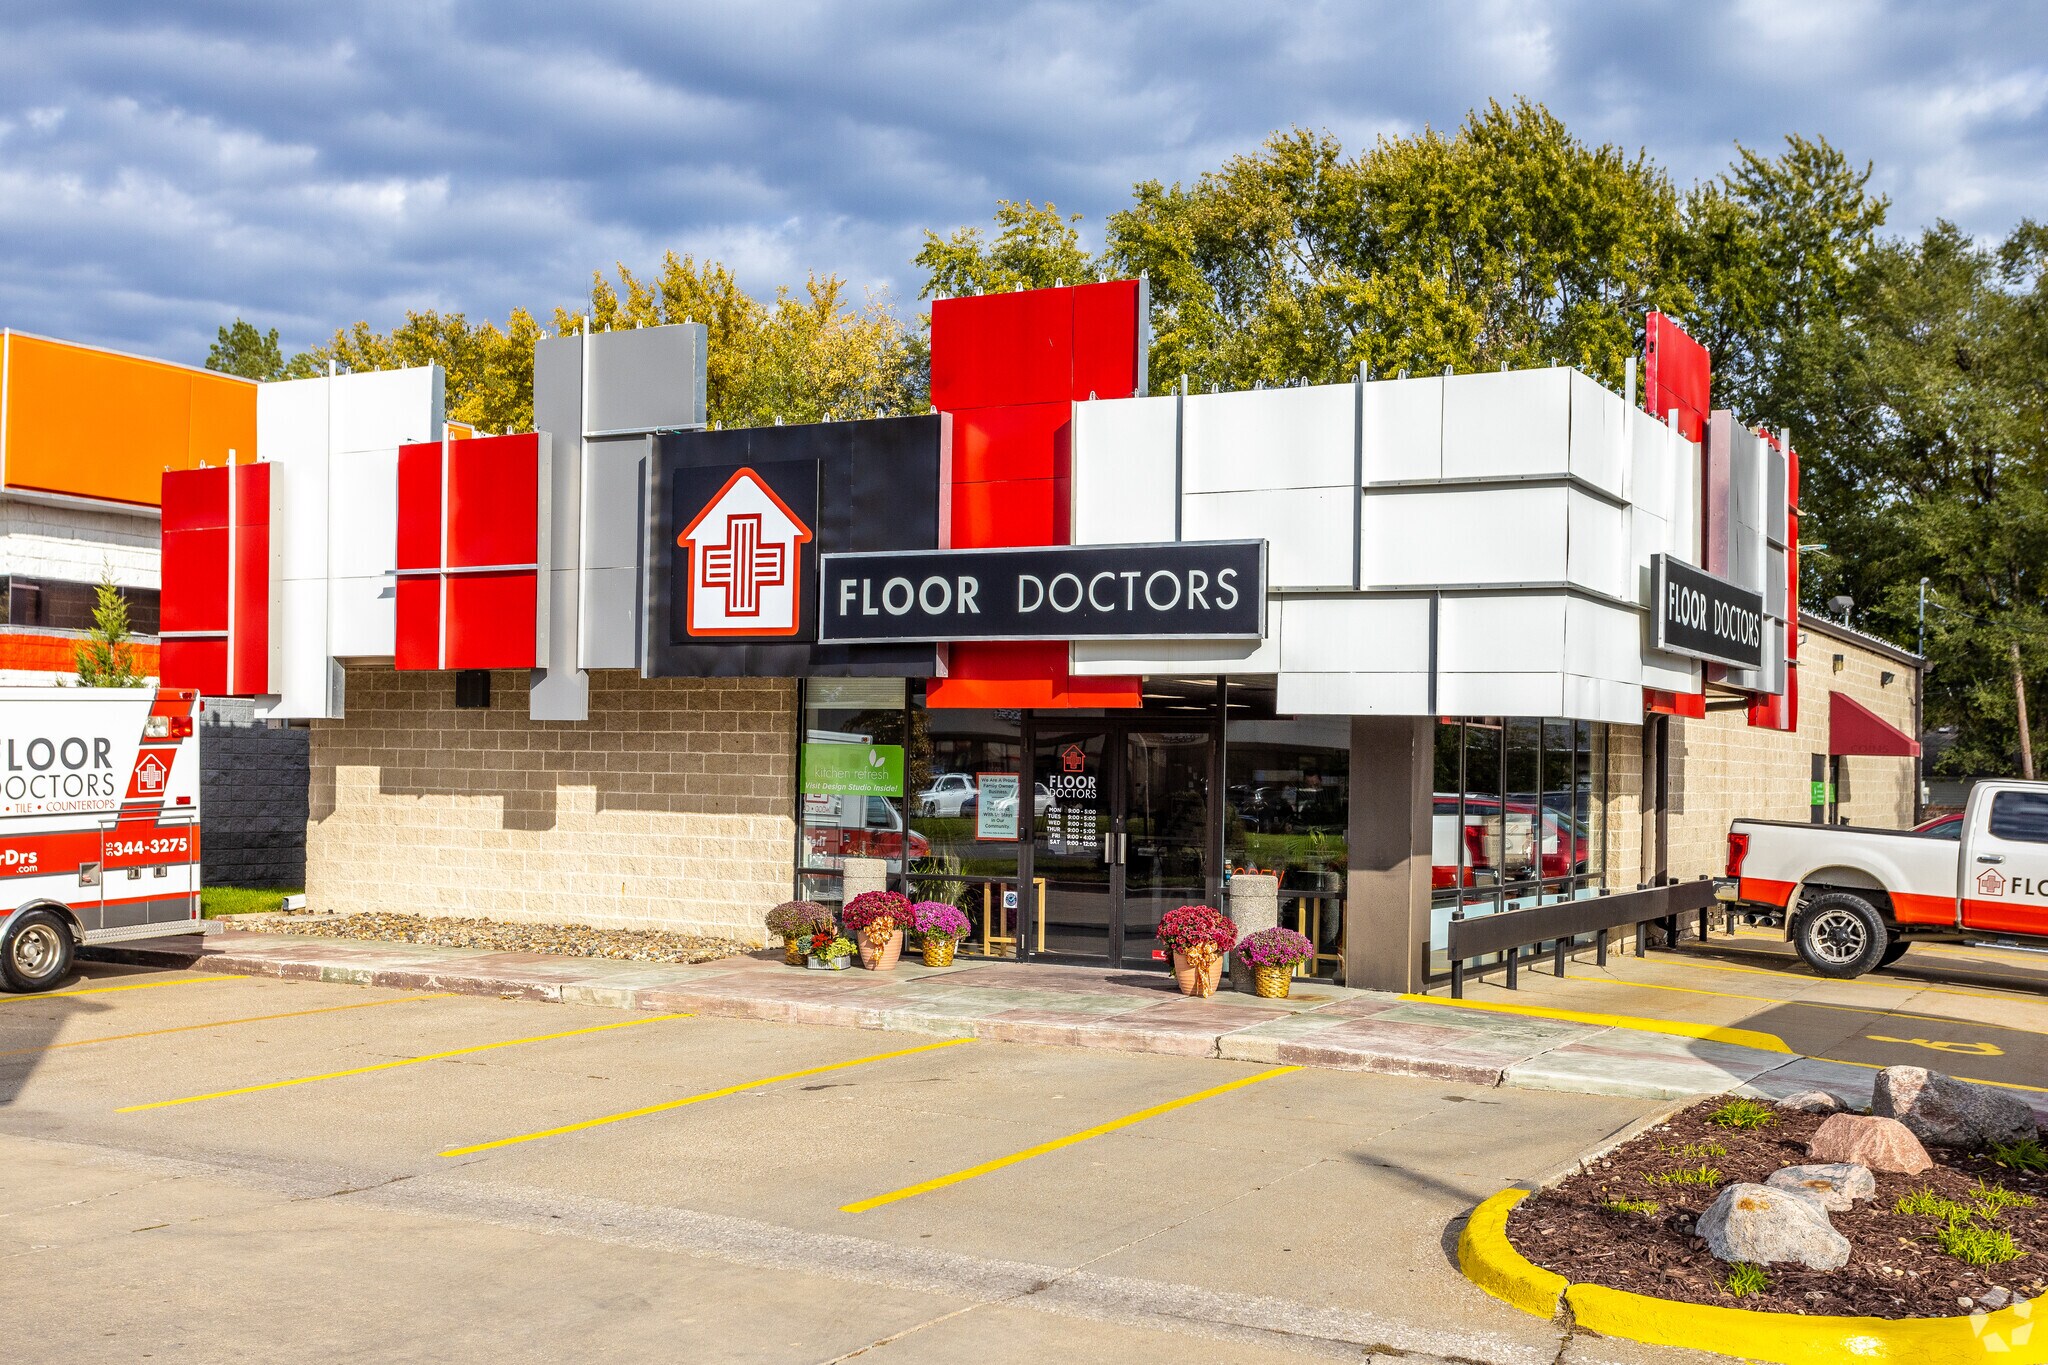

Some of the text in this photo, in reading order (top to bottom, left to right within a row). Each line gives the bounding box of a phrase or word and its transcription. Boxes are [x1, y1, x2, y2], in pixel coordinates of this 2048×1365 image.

[839, 567, 1240, 616] FLOOR DOCTORS
[1669, 581, 1760, 648] FLOOR DOCTORS
[0, 737, 112, 771] LOOR
[814, 765, 889, 780] kitchen refresh
[0, 773, 114, 800] OCTORS
[1050, 775, 1096, 788] FLOOR
[1050, 788, 1097, 798] DOCTORS
[15, 799, 115, 813] TILE COUNTERTOPS
[114, 838, 187, 856] 344-3275
[16, 865, 38, 874] .com
